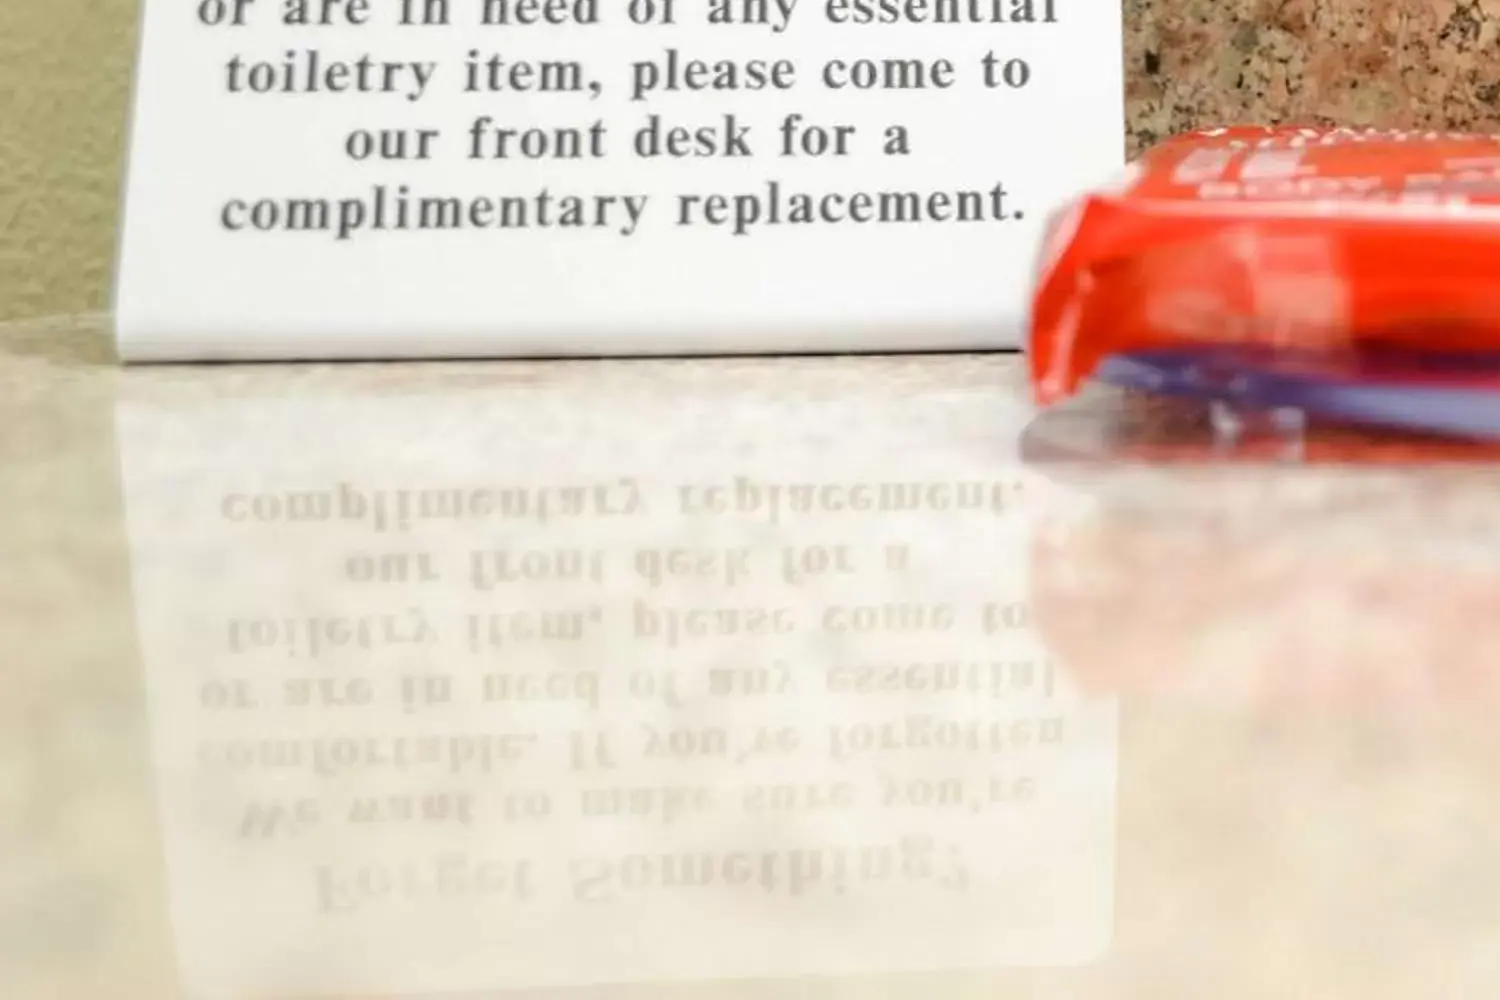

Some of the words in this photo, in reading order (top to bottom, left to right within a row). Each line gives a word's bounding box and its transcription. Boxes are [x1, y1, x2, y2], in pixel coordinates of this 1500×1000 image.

[225, 49, 435, 101] toiletry
[464, 49, 602, 96] item,
[632, 48, 795, 99] please
[822, 59, 955, 90] come
[981, 50, 1030, 89] to
[344, 129, 440, 161] our
[468, 116, 607, 159] front
[633, 114, 752, 158] desk
[779, 114, 856, 156] for
[883, 126, 910, 156] a
[220, 185, 648, 238] complimentary
[677, 181, 1025, 236] replacement.
